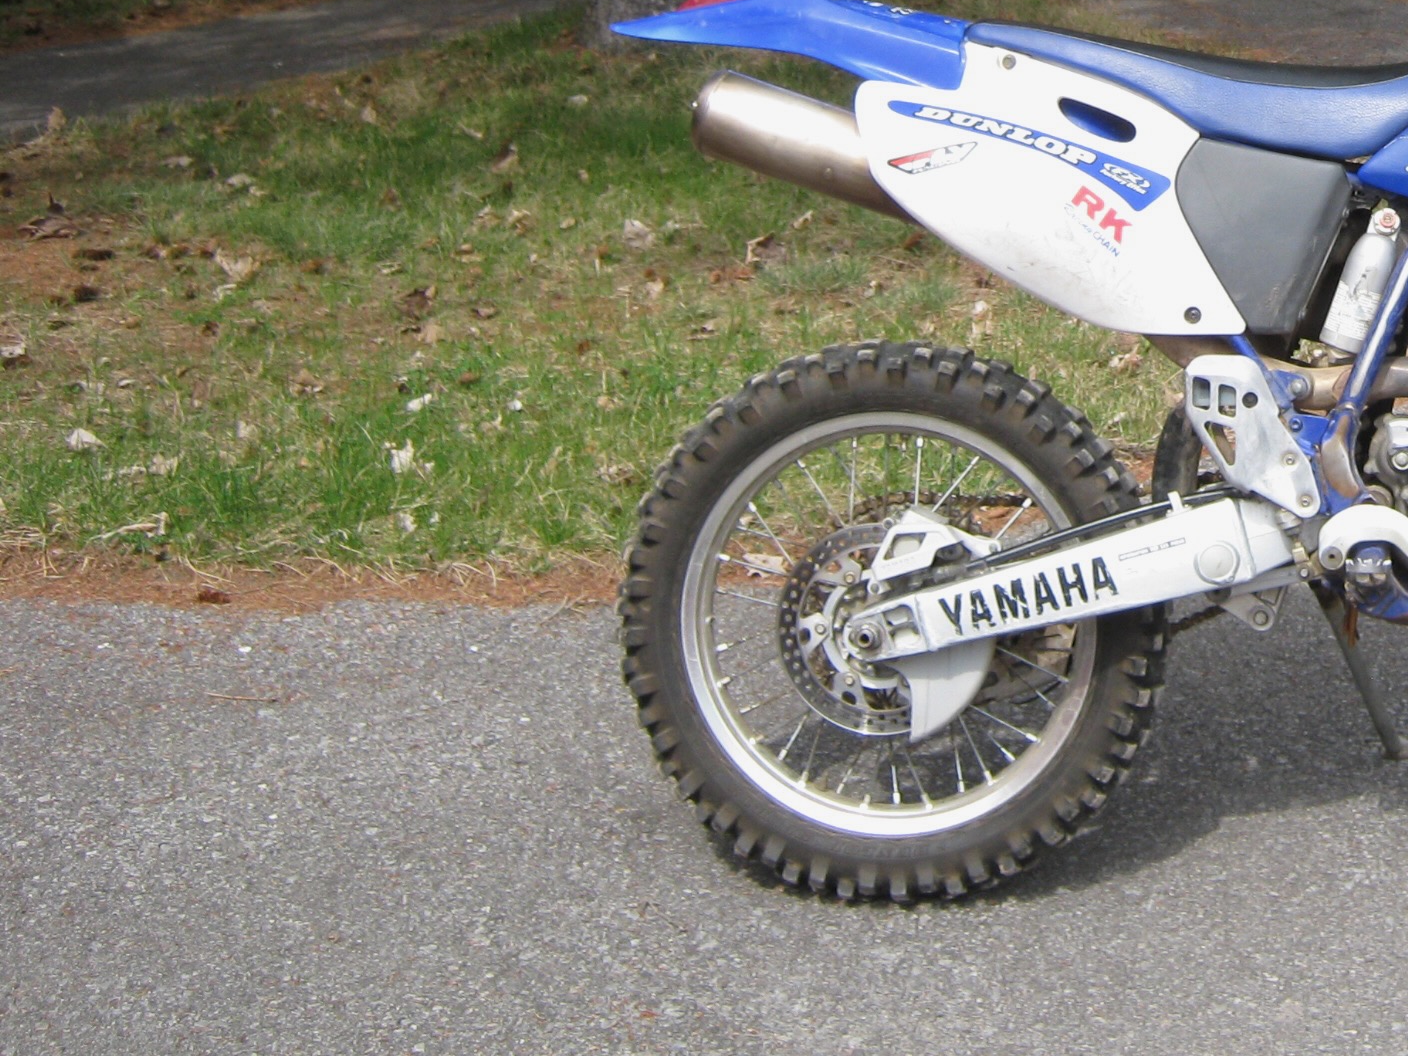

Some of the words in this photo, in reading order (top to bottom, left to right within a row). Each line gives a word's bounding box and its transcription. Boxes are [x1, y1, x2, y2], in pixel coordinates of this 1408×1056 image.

[914, 105, 1098, 165] DUNLOP
[1071, 185, 1133, 245] RK
[1092, 230, 1120, 258] CHAIN
[938, 556, 1119, 636] YAMAHA
